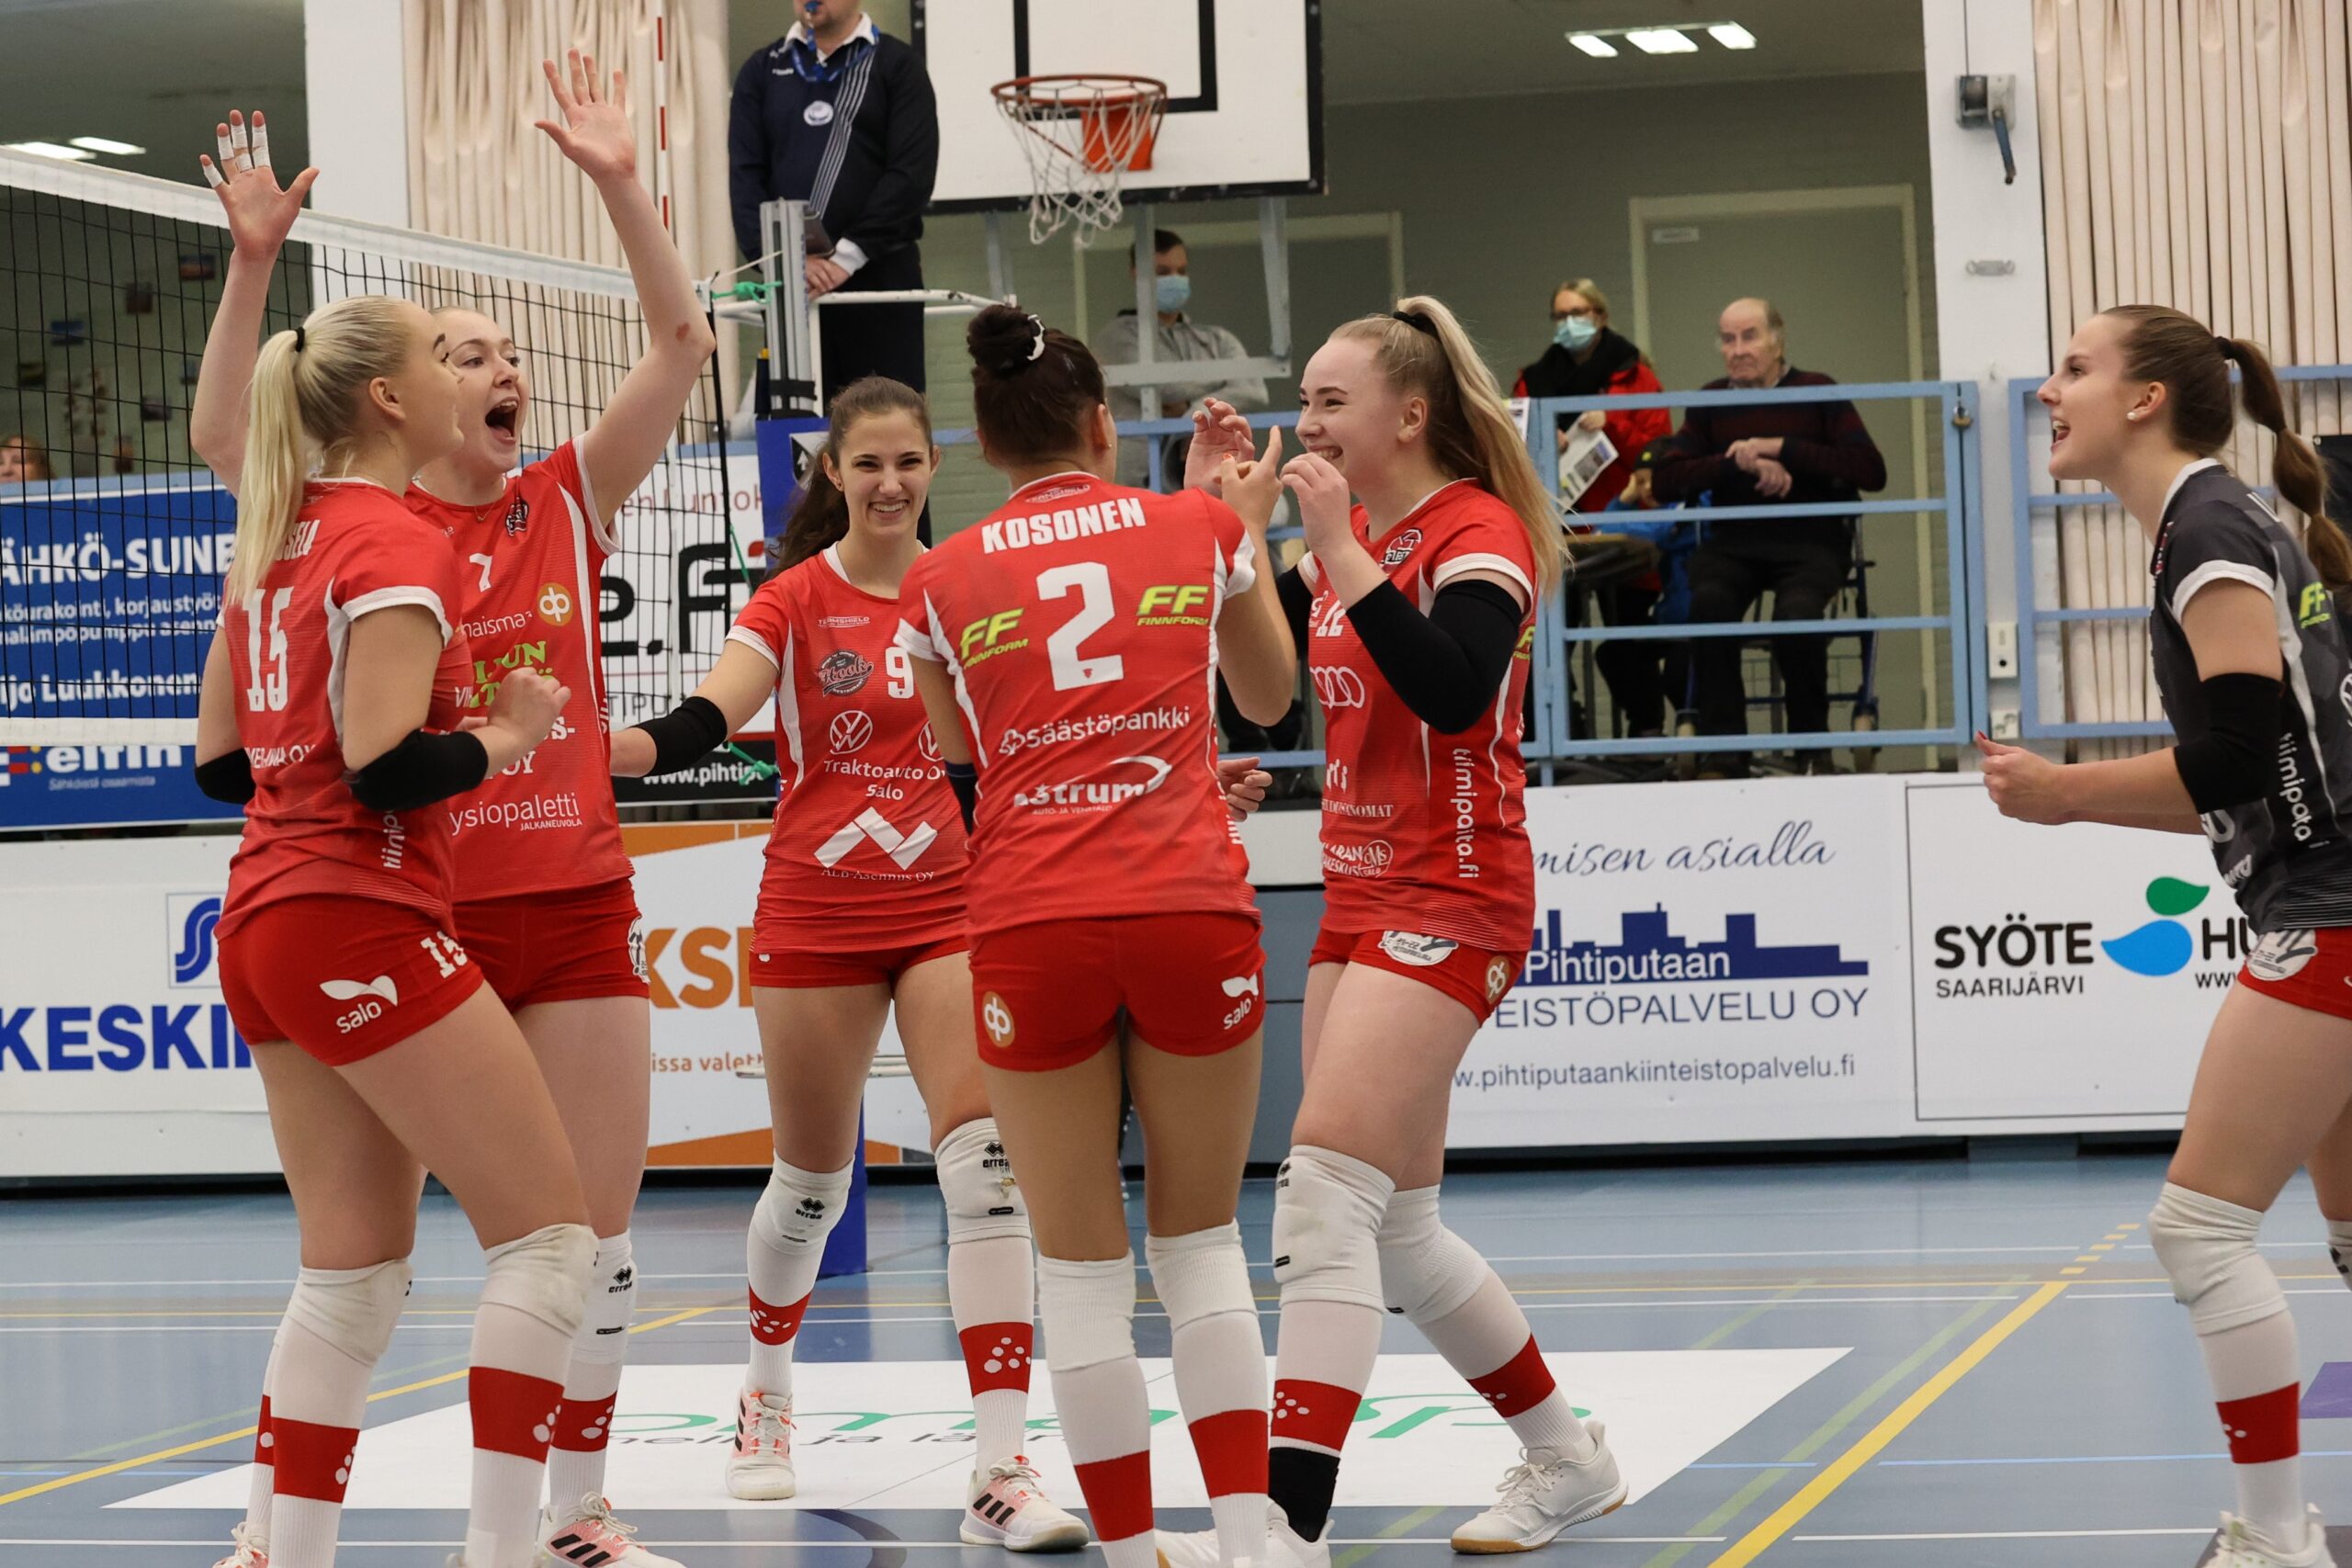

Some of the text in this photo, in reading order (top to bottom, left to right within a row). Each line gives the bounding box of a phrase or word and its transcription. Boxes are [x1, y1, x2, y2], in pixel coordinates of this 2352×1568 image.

[981, 498, 1147, 554] KOSONEN
[469, 553, 492, 592] 7
[1137, 586, 1210, 615] FF
[961, 607, 1023, 660] FF
[1036, 562, 1124, 692] 2
[243, 586, 294, 713] 15
[885, 647, 915, 698] 9
[1026, 705, 1191, 749] säästöpankki
[824, 759, 924, 780] Traktoauto
[865, 784, 904, 800] Salo
[449, 793, 580, 836] ysiopaletti
[520, 818, 582, 831] JALKANEUVOLA
[1450, 749, 1479, 879] tiimipaita.fi
[1667, 819, 1836, 873] asialla
[420, 931, 468, 978] 15
[1935, 913, 2094, 969] SYÖTE
[1524, 947, 1731, 985] Pihtiputaan
[1936, 971, 2084, 998] SAARIJÄRVI
[336, 1001, 382, 1033] salo
[1224, 998, 1252, 1030] salo
[1496, 988, 1869, 1028] EISTÖPALVELU OY
[651, 1052, 692, 1072] issa
[799, 1434, 881, 1446] ja
